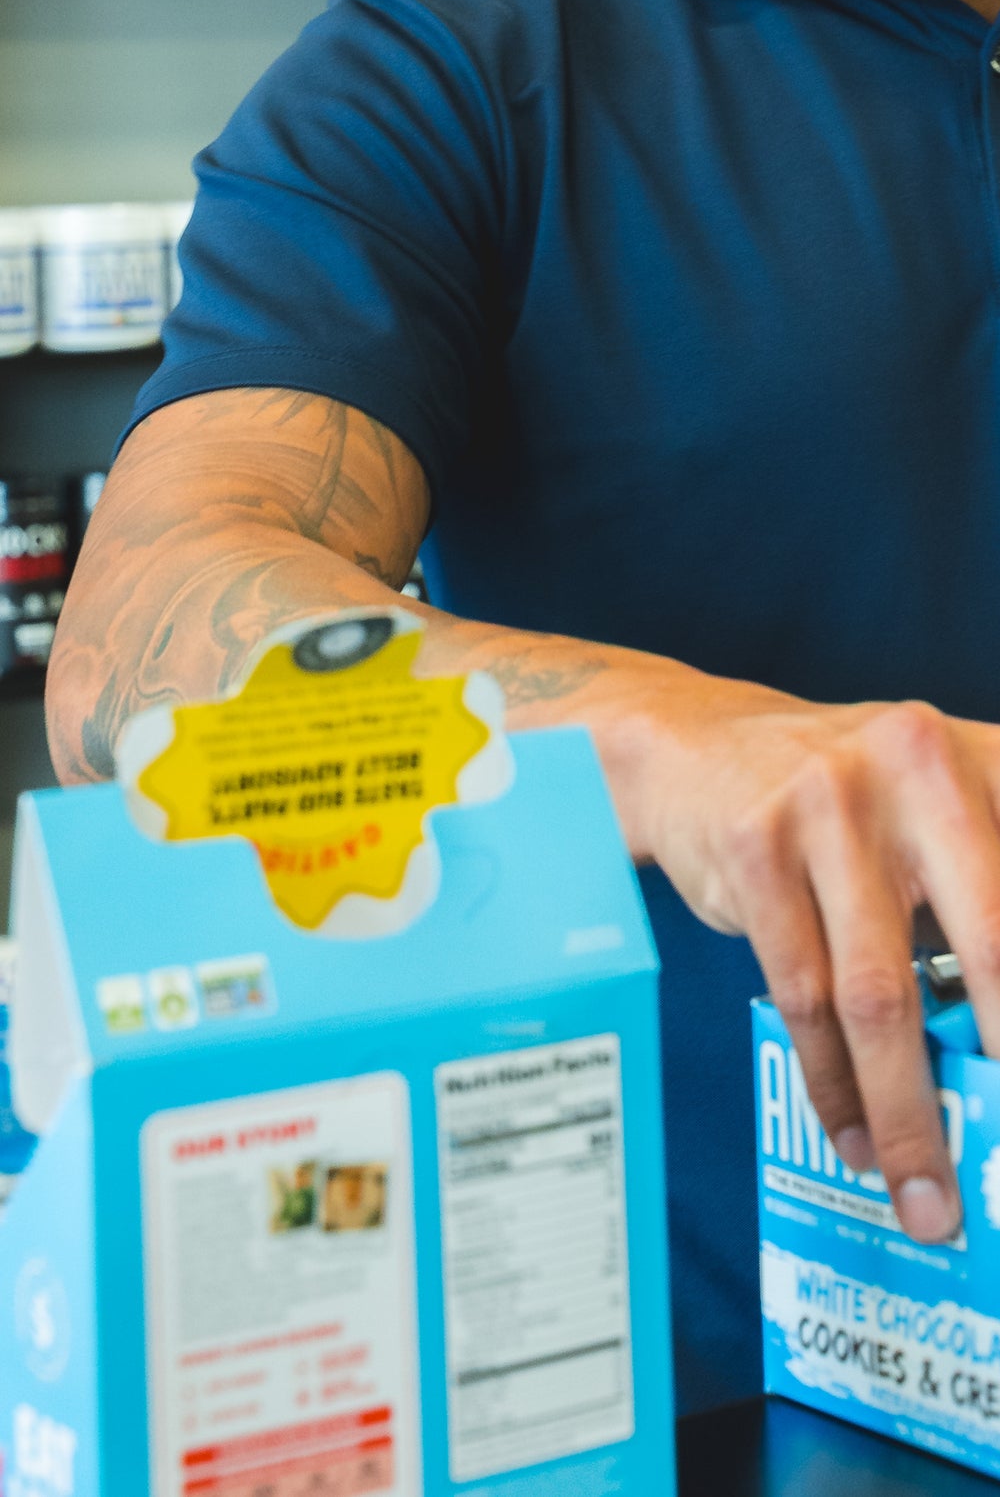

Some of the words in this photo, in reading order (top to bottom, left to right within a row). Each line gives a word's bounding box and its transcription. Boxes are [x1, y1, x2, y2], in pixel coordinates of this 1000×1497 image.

[796, 1267, 866, 1323] WHITE
[798, 1314, 907, 1386] COOKIES
[919, 1356, 939, 1397] &
